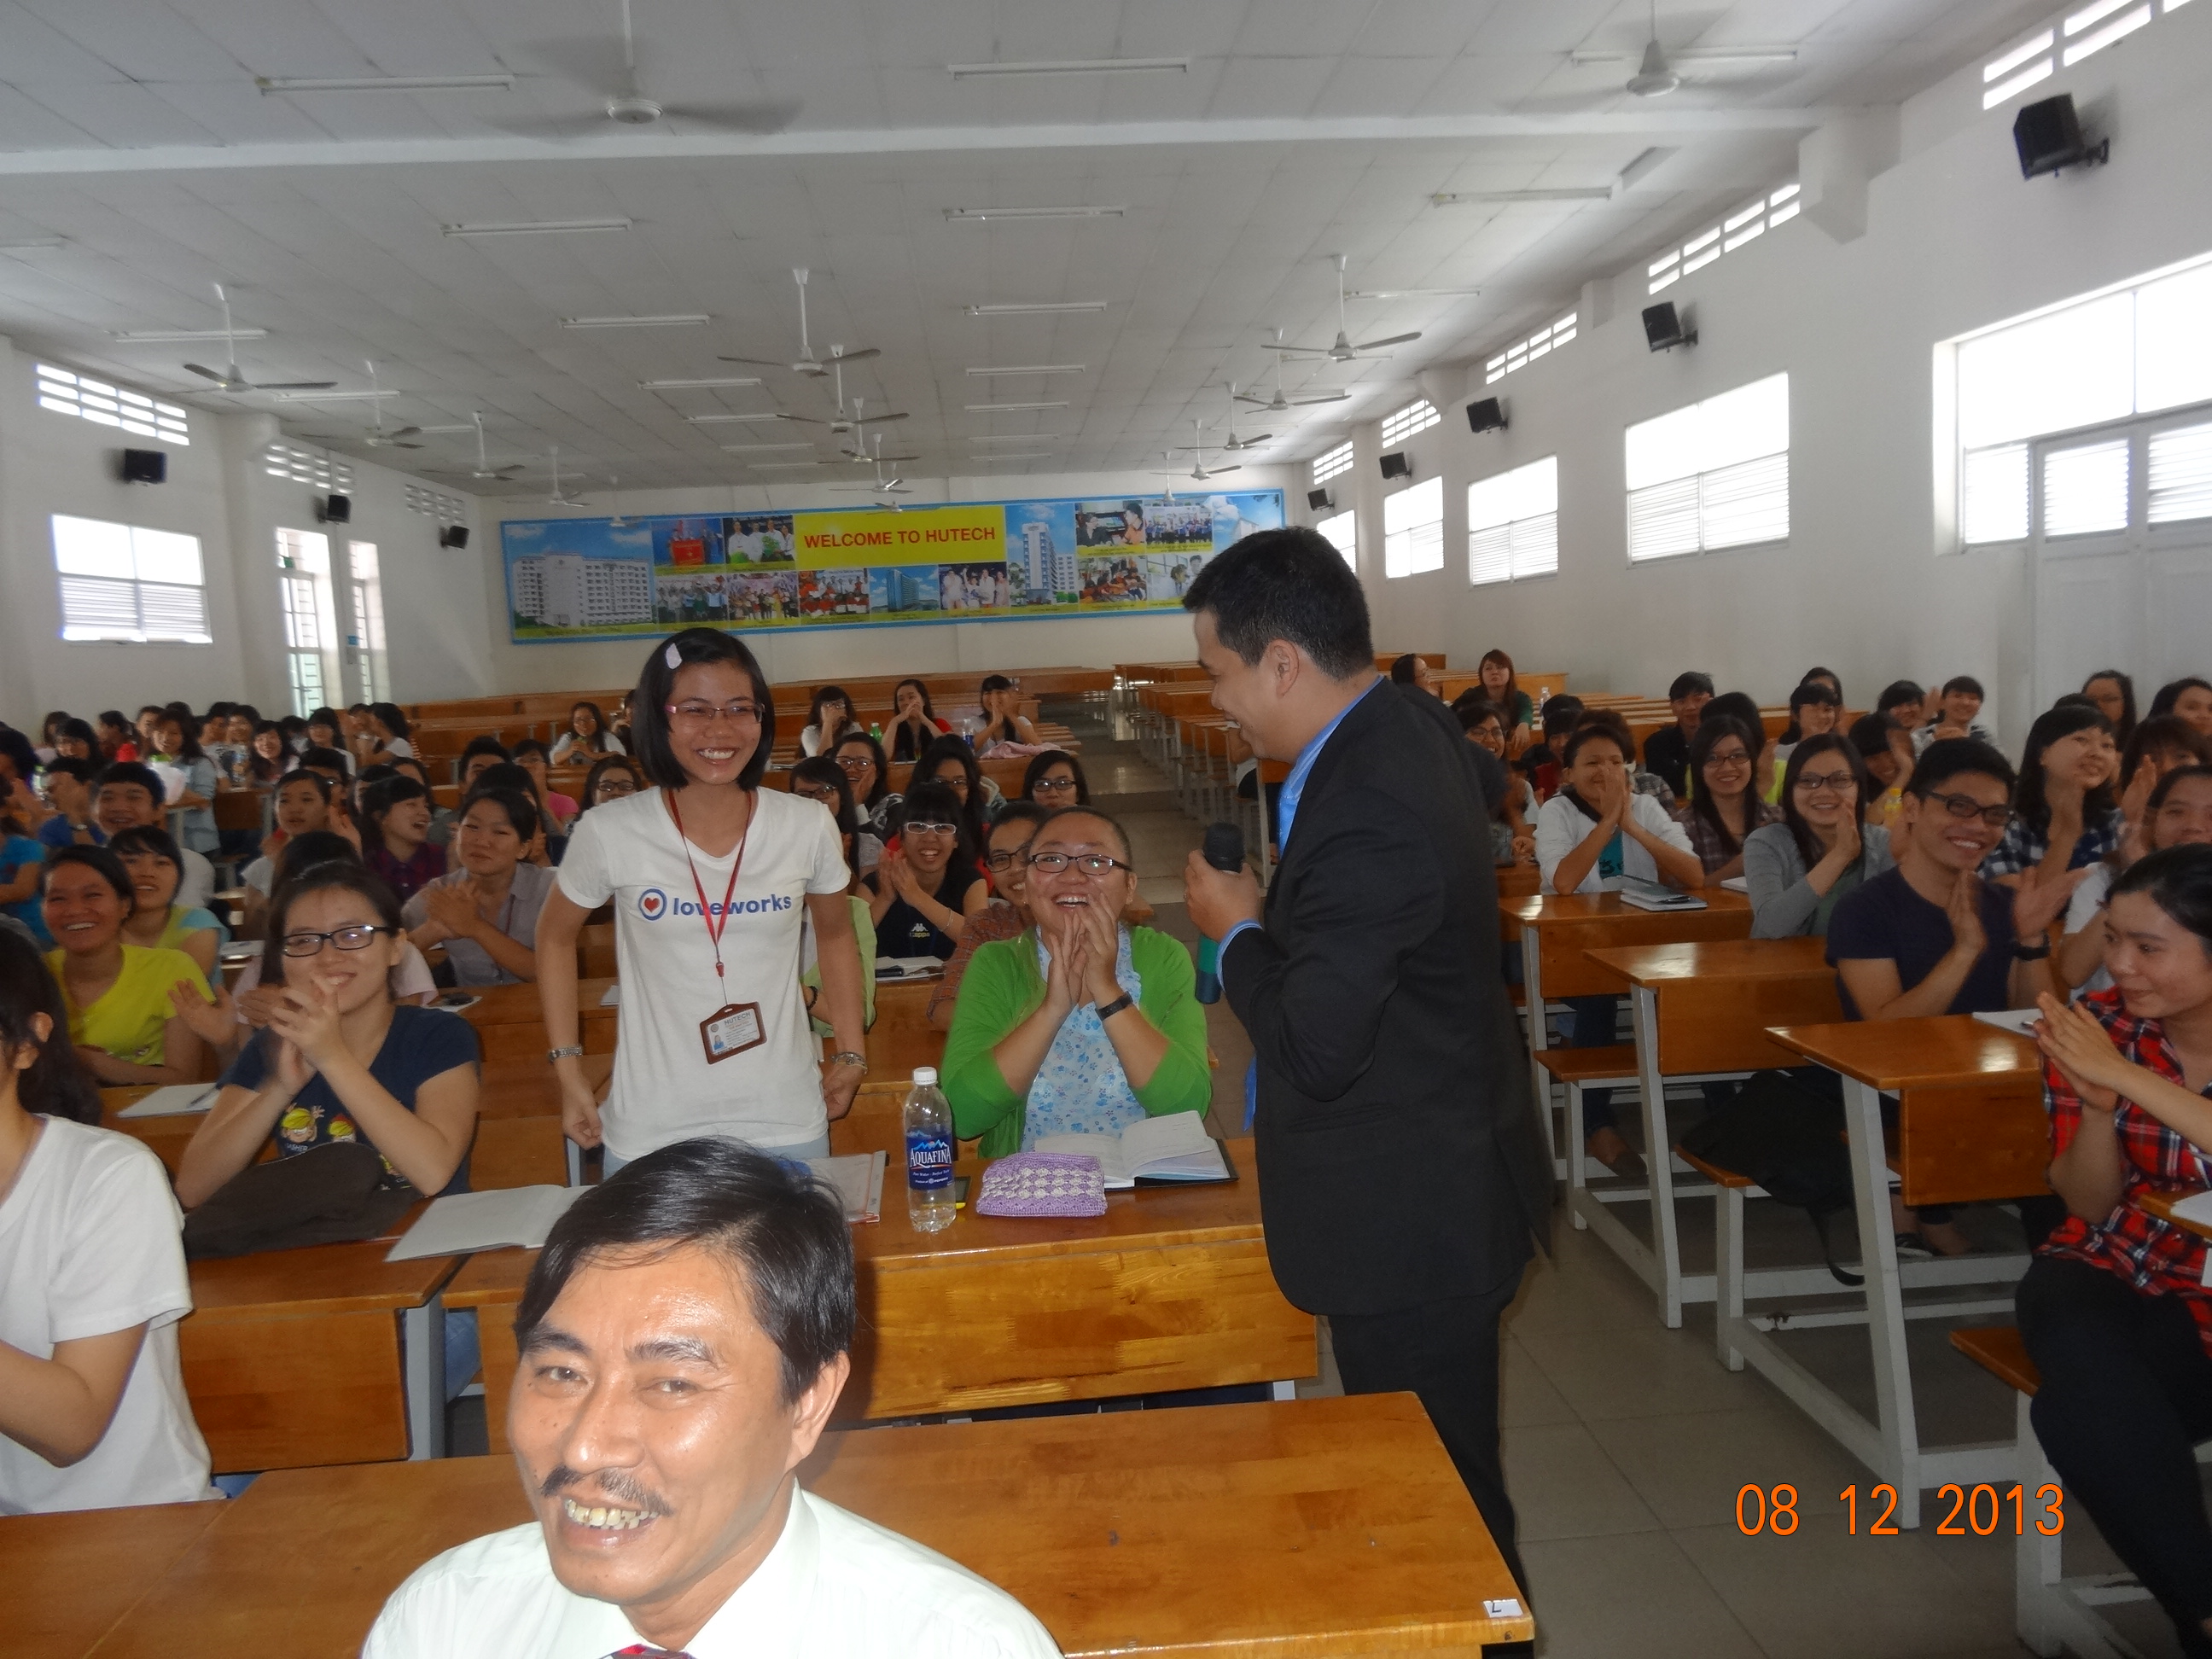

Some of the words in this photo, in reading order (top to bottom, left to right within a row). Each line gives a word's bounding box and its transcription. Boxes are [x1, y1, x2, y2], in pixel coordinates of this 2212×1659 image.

[804, 532, 893, 548] WELCOME
[898, 530, 920, 544] TO
[926, 527, 996, 543] HUTECH
[724, 1011, 751, 1025] HUTECH
[910, 1145, 952, 1168] AQUAFINA
